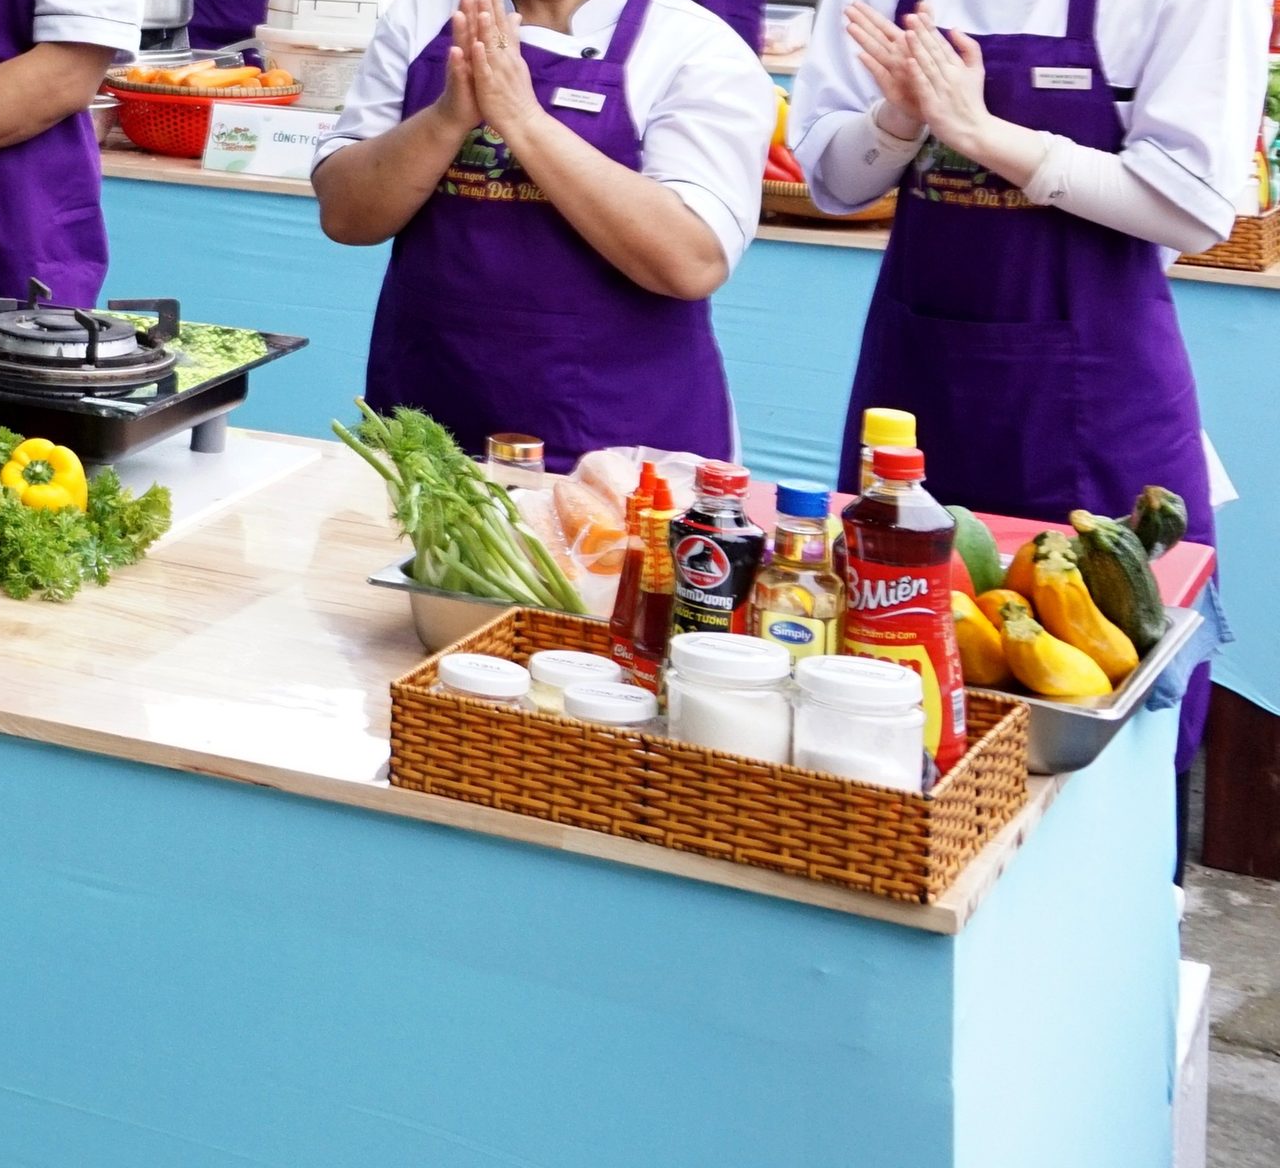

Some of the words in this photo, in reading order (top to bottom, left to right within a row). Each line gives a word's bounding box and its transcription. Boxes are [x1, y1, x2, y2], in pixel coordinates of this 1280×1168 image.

[273, 131, 297, 144] CÔNG
[299, 135, 309, 145] TY
[464, 169, 486, 183] ngon
[487, 181, 515, 200] Đà
[974, 187, 1000, 207] Đà
[771, 624, 813, 643] Simply
